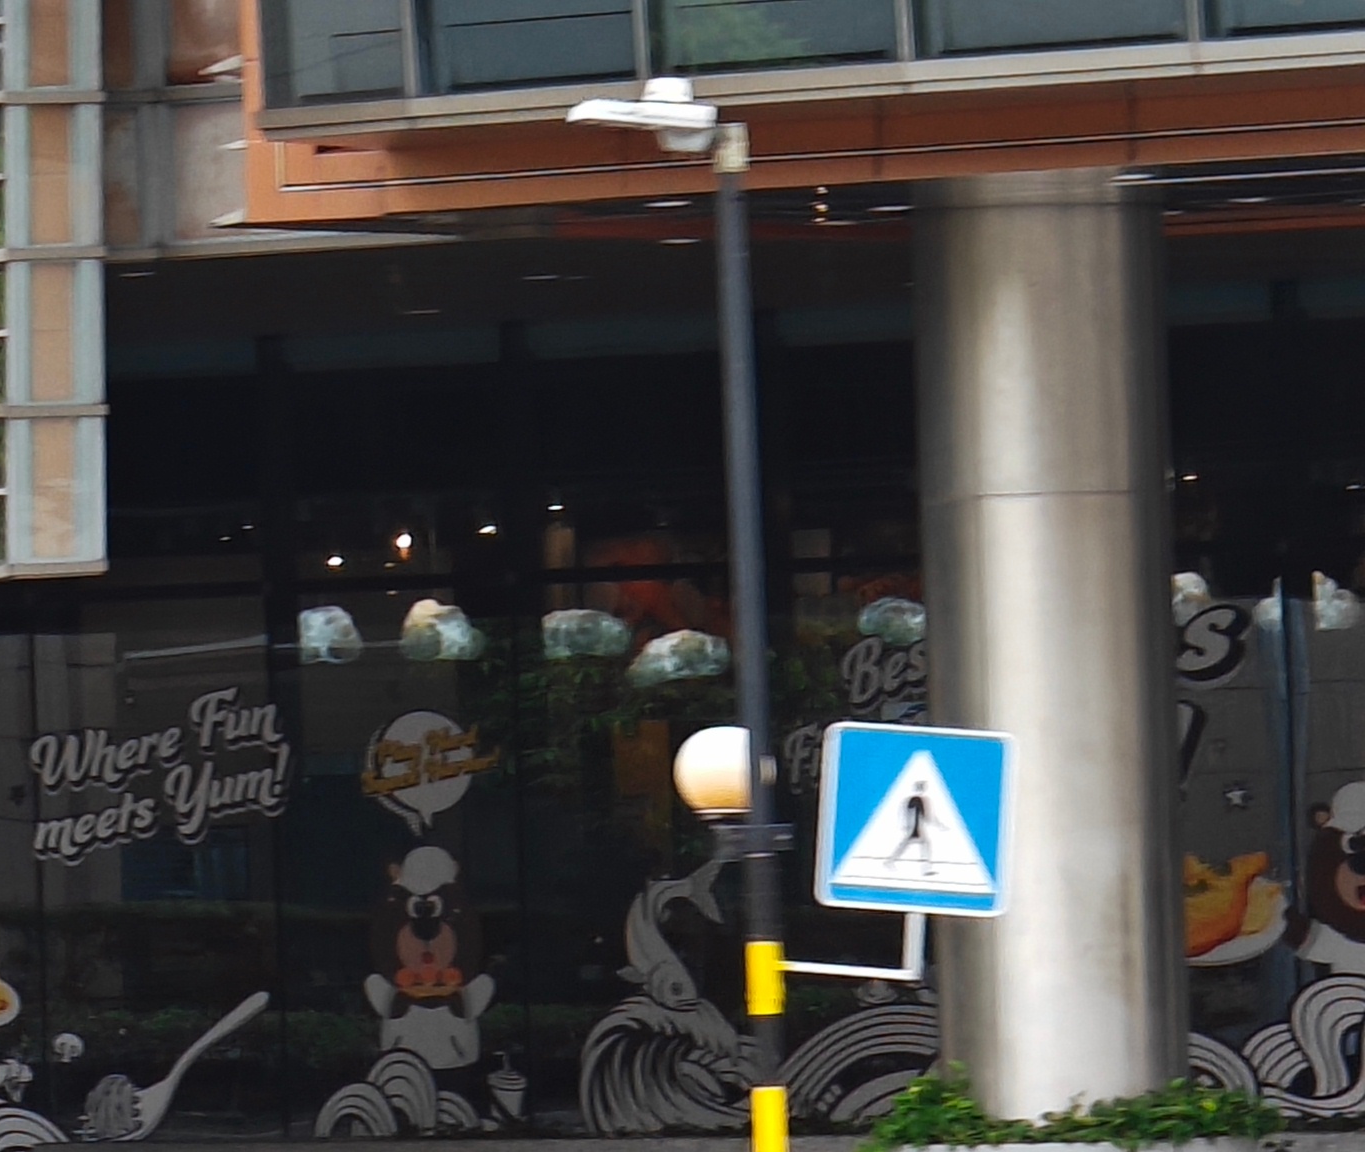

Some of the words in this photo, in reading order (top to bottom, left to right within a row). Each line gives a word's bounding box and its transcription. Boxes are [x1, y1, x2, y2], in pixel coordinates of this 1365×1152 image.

[31, 727, 183, 794] Where
[190, 686, 284, 752] Fun
[33, 793, 157, 864] meets
[164, 743, 290, 842] Yum!
